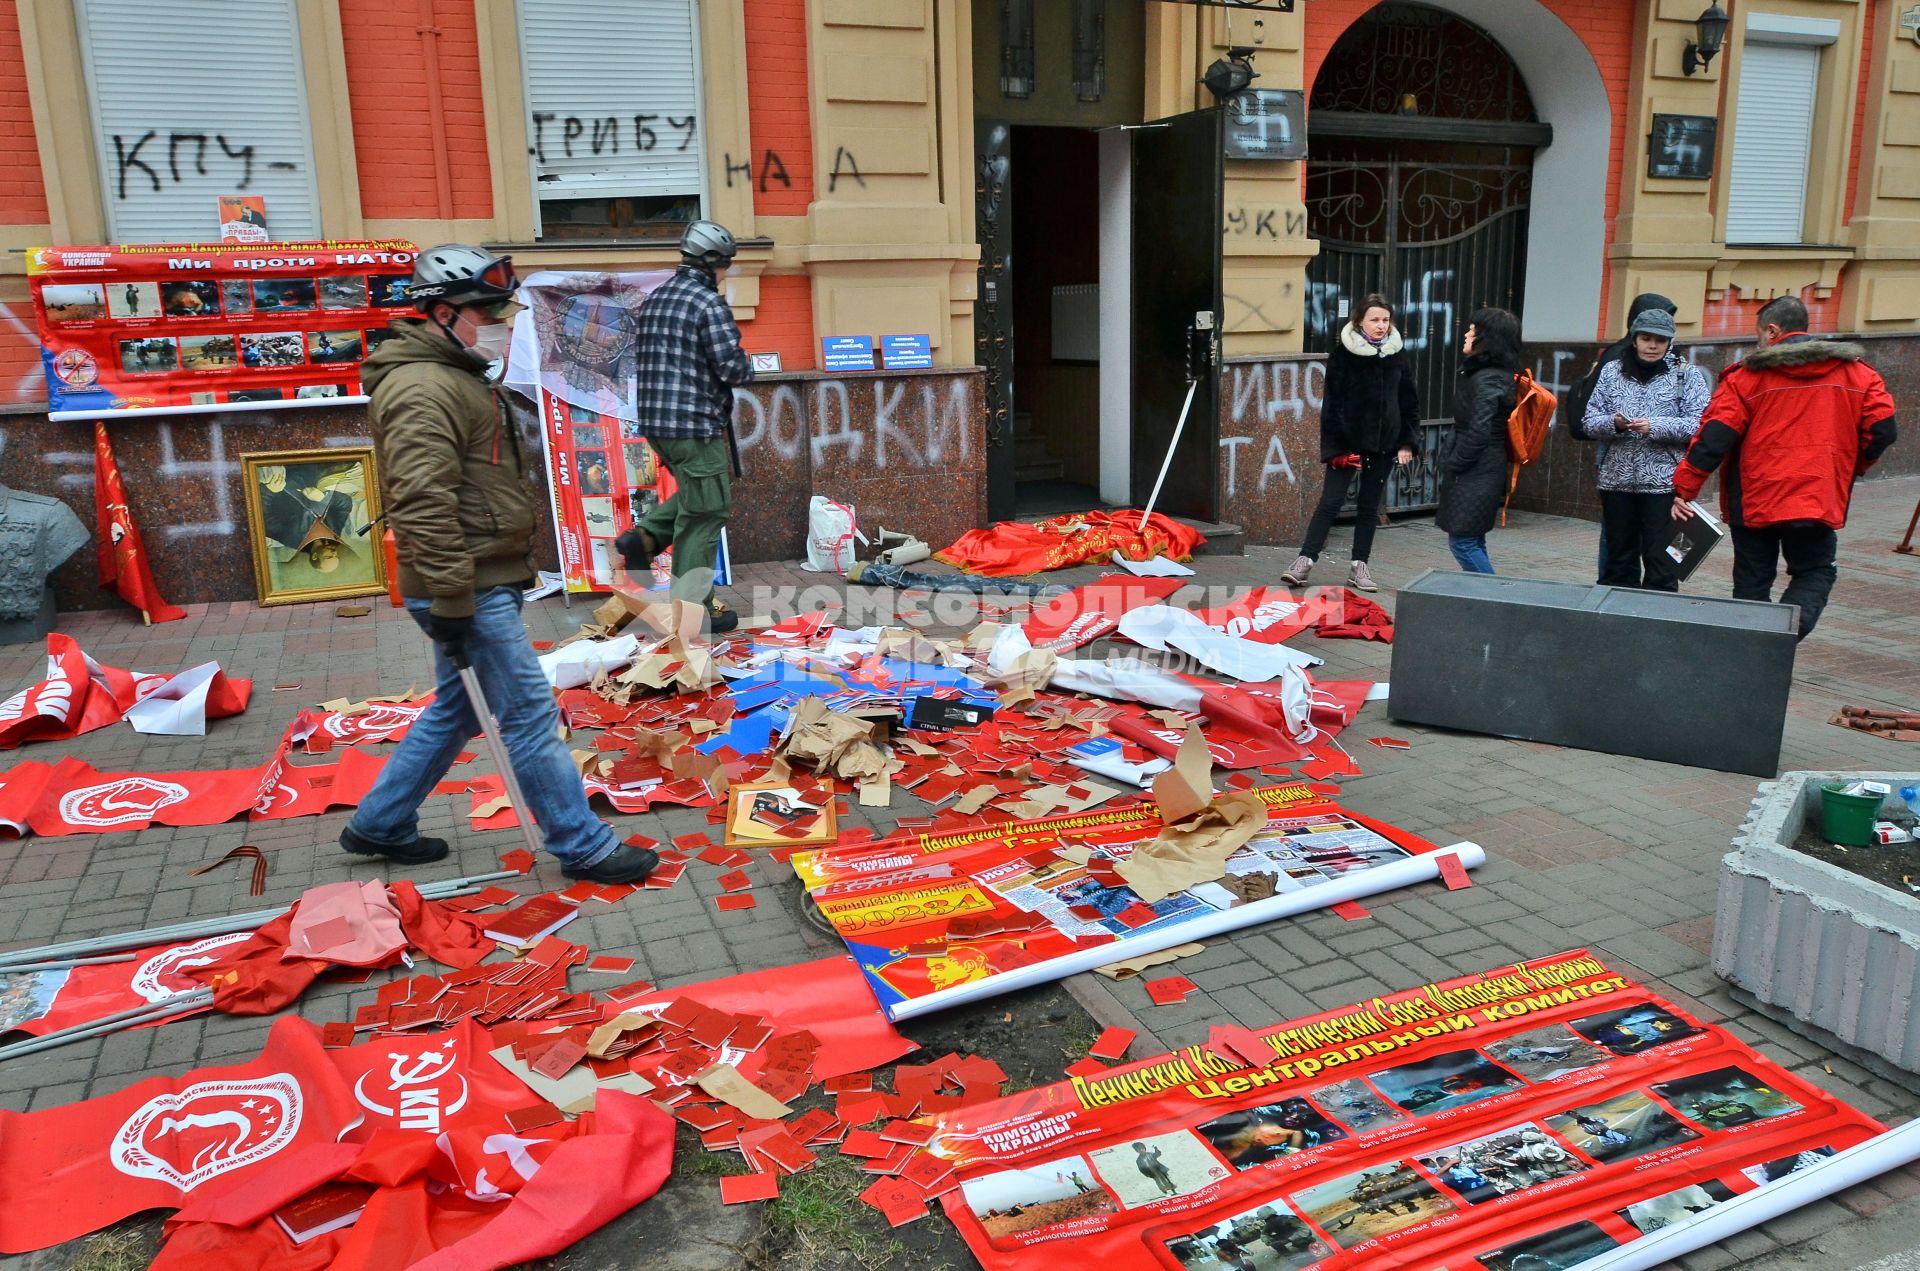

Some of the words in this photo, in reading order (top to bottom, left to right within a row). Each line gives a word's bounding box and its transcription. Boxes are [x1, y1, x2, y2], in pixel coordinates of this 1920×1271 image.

[113, 131, 253, 198] КПУ
[62, 258, 105, 266] УКРАИНЫ
[167, 258, 212, 271] Ми
[233, 256, 315, 270] проти
[1219, 434, 1297, 499] ТА
[834, 893, 987, 932] 99234
[1371, 996, 1441, 1028] Союз
[1185, 1010, 1478, 1101] Центральный
[1480, 976, 1631, 1023] комитет
[1551, 1072, 1574, 1085] НАТО
[1434, 1110, 1458, 1122] НАТО
[1476, 1100, 1494, 1110] свет
[982, 1110, 1078, 1145] КОМСОМОЛ
[987, 1121, 1071, 1154] УКРАИНЫ
[1358, 1132, 1377, 1143] Они
[1389, 1121, 1417, 1134] хотели
[1727, 1123, 1750, 1135] НАТО
[1263, 1159, 1286, 1171] Буш!
[1288, 1155, 1300, 1165] Ты
[1307, 1144, 1335, 1157] ответе
[1658, 1145, 1685, 1159] хотите
[1145, 1199, 1170, 1211] НАТО
[1193, 1183, 1222, 1202] работу
[1495, 1191, 1521, 1205] НАТО
[1541, 1173, 1587, 1193] демократия
[1014, 1229, 1041, 1241] НАТО
[1067, 1216, 1101, 1232] дружба
[1023, 1225, 1109, 1247] взаимопонимание!
[1352, 1238, 1379, 1254] НАТО
[1385, 1232, 1402, 1243] это
[1402, 1223, 1430, 1237] новые
[1430, 1212, 1461, 1228] друзья
